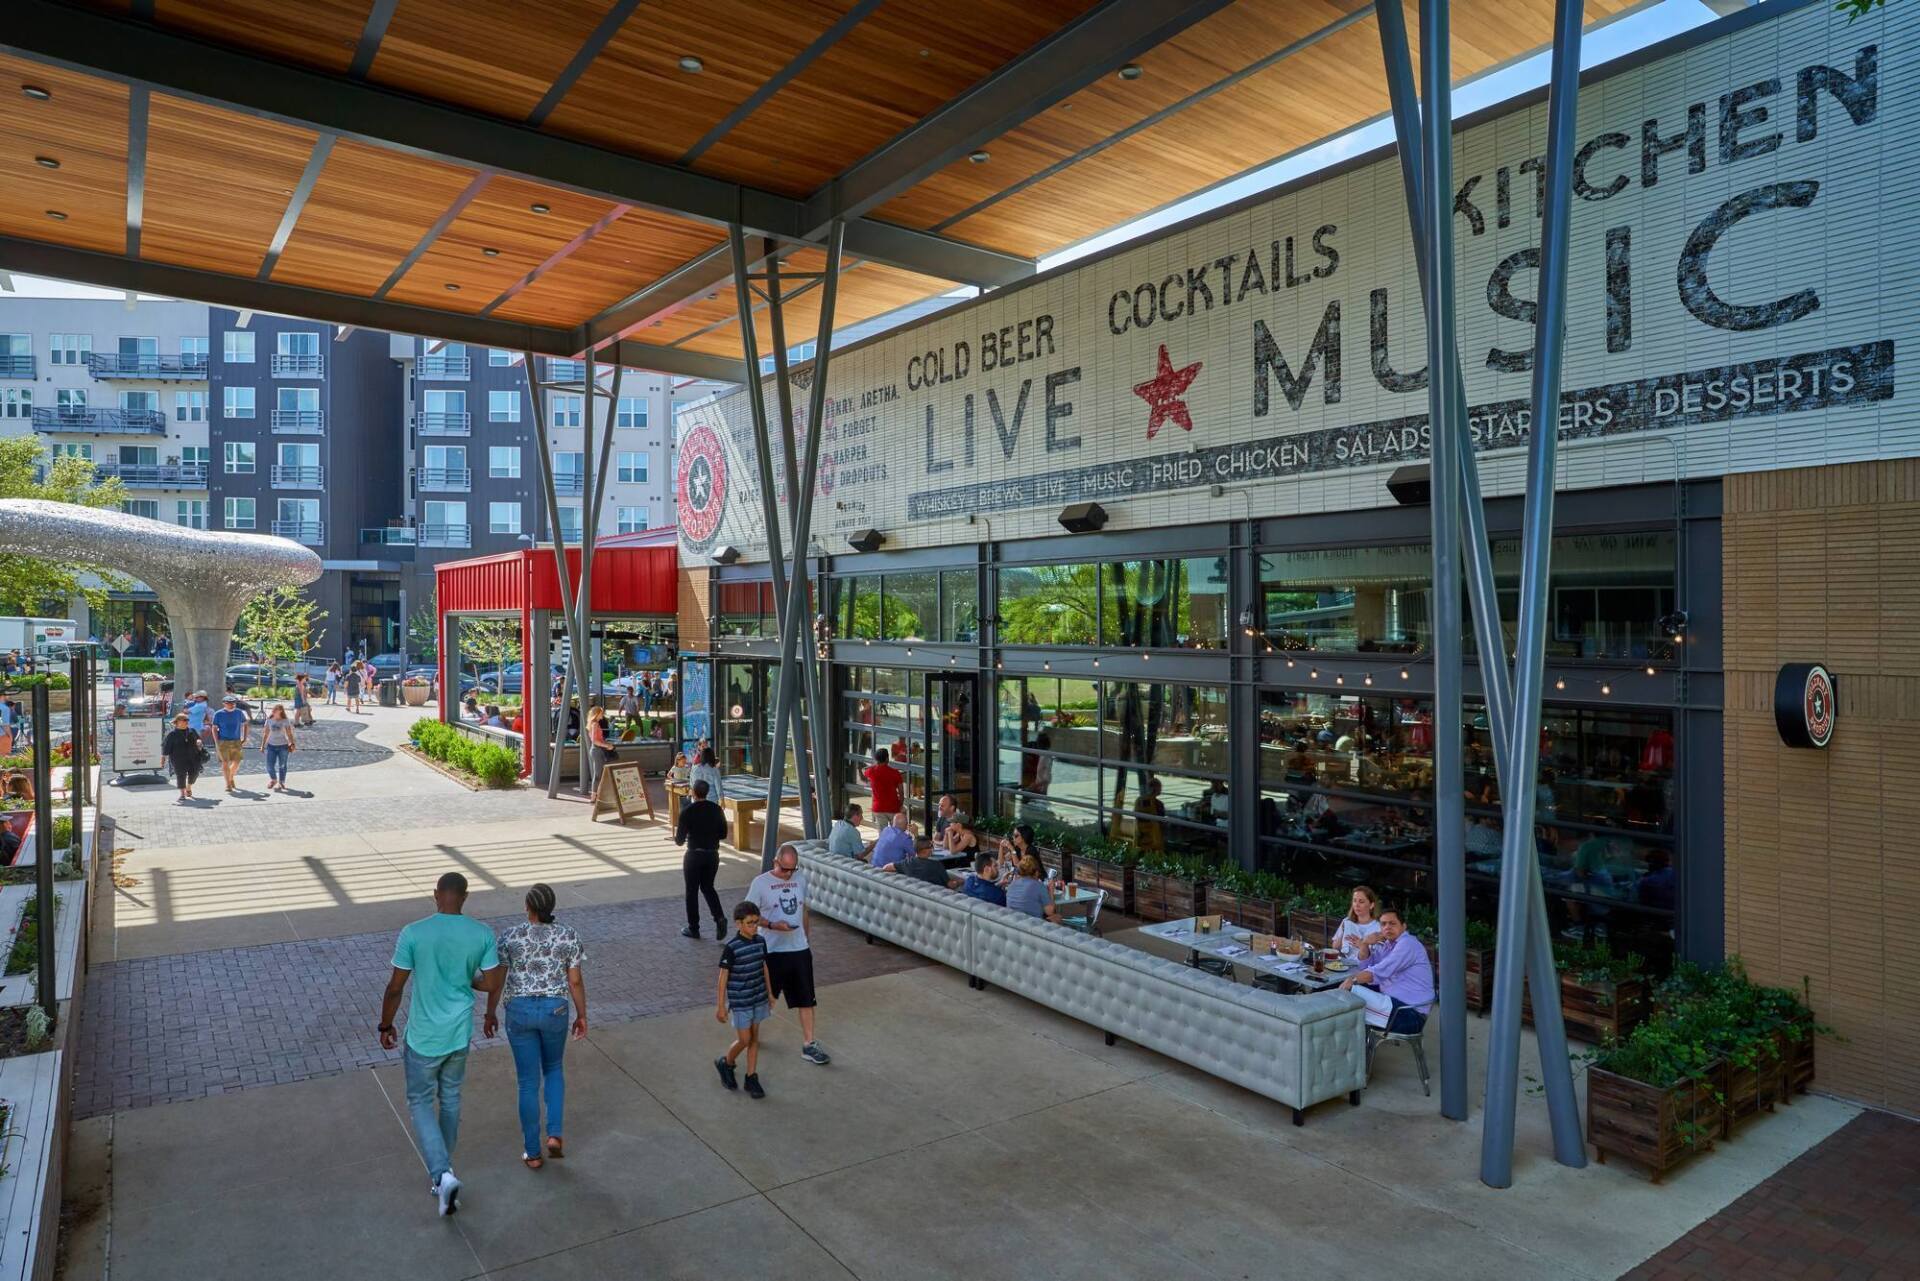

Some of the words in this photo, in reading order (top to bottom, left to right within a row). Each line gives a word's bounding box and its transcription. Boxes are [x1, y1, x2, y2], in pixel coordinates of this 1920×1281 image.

[907, 341, 970, 391] COLD
[981, 315, 1055, 372] BEER
[1108, 224, 1340, 335] COCKTAILS
[1453, 44, 1878, 236] KITCHEN
[915, 492, 967, 513] WHISKEY
[979, 484, 1024, 507] BREWS
[1036, 479, 1066, 499] LIVE
[1083, 469, 1133, 492] MUSIC
[1152, 458, 1202, 483] FRIED
[1215, 441, 1309, 475] CHICKEN
[1336, 424, 1430, 460] SALADS
[1468, 398, 1614, 442] STARERS
[1655, 361, 1857, 417] DESSERTS
[925, 367, 1082, 474] LIVE
